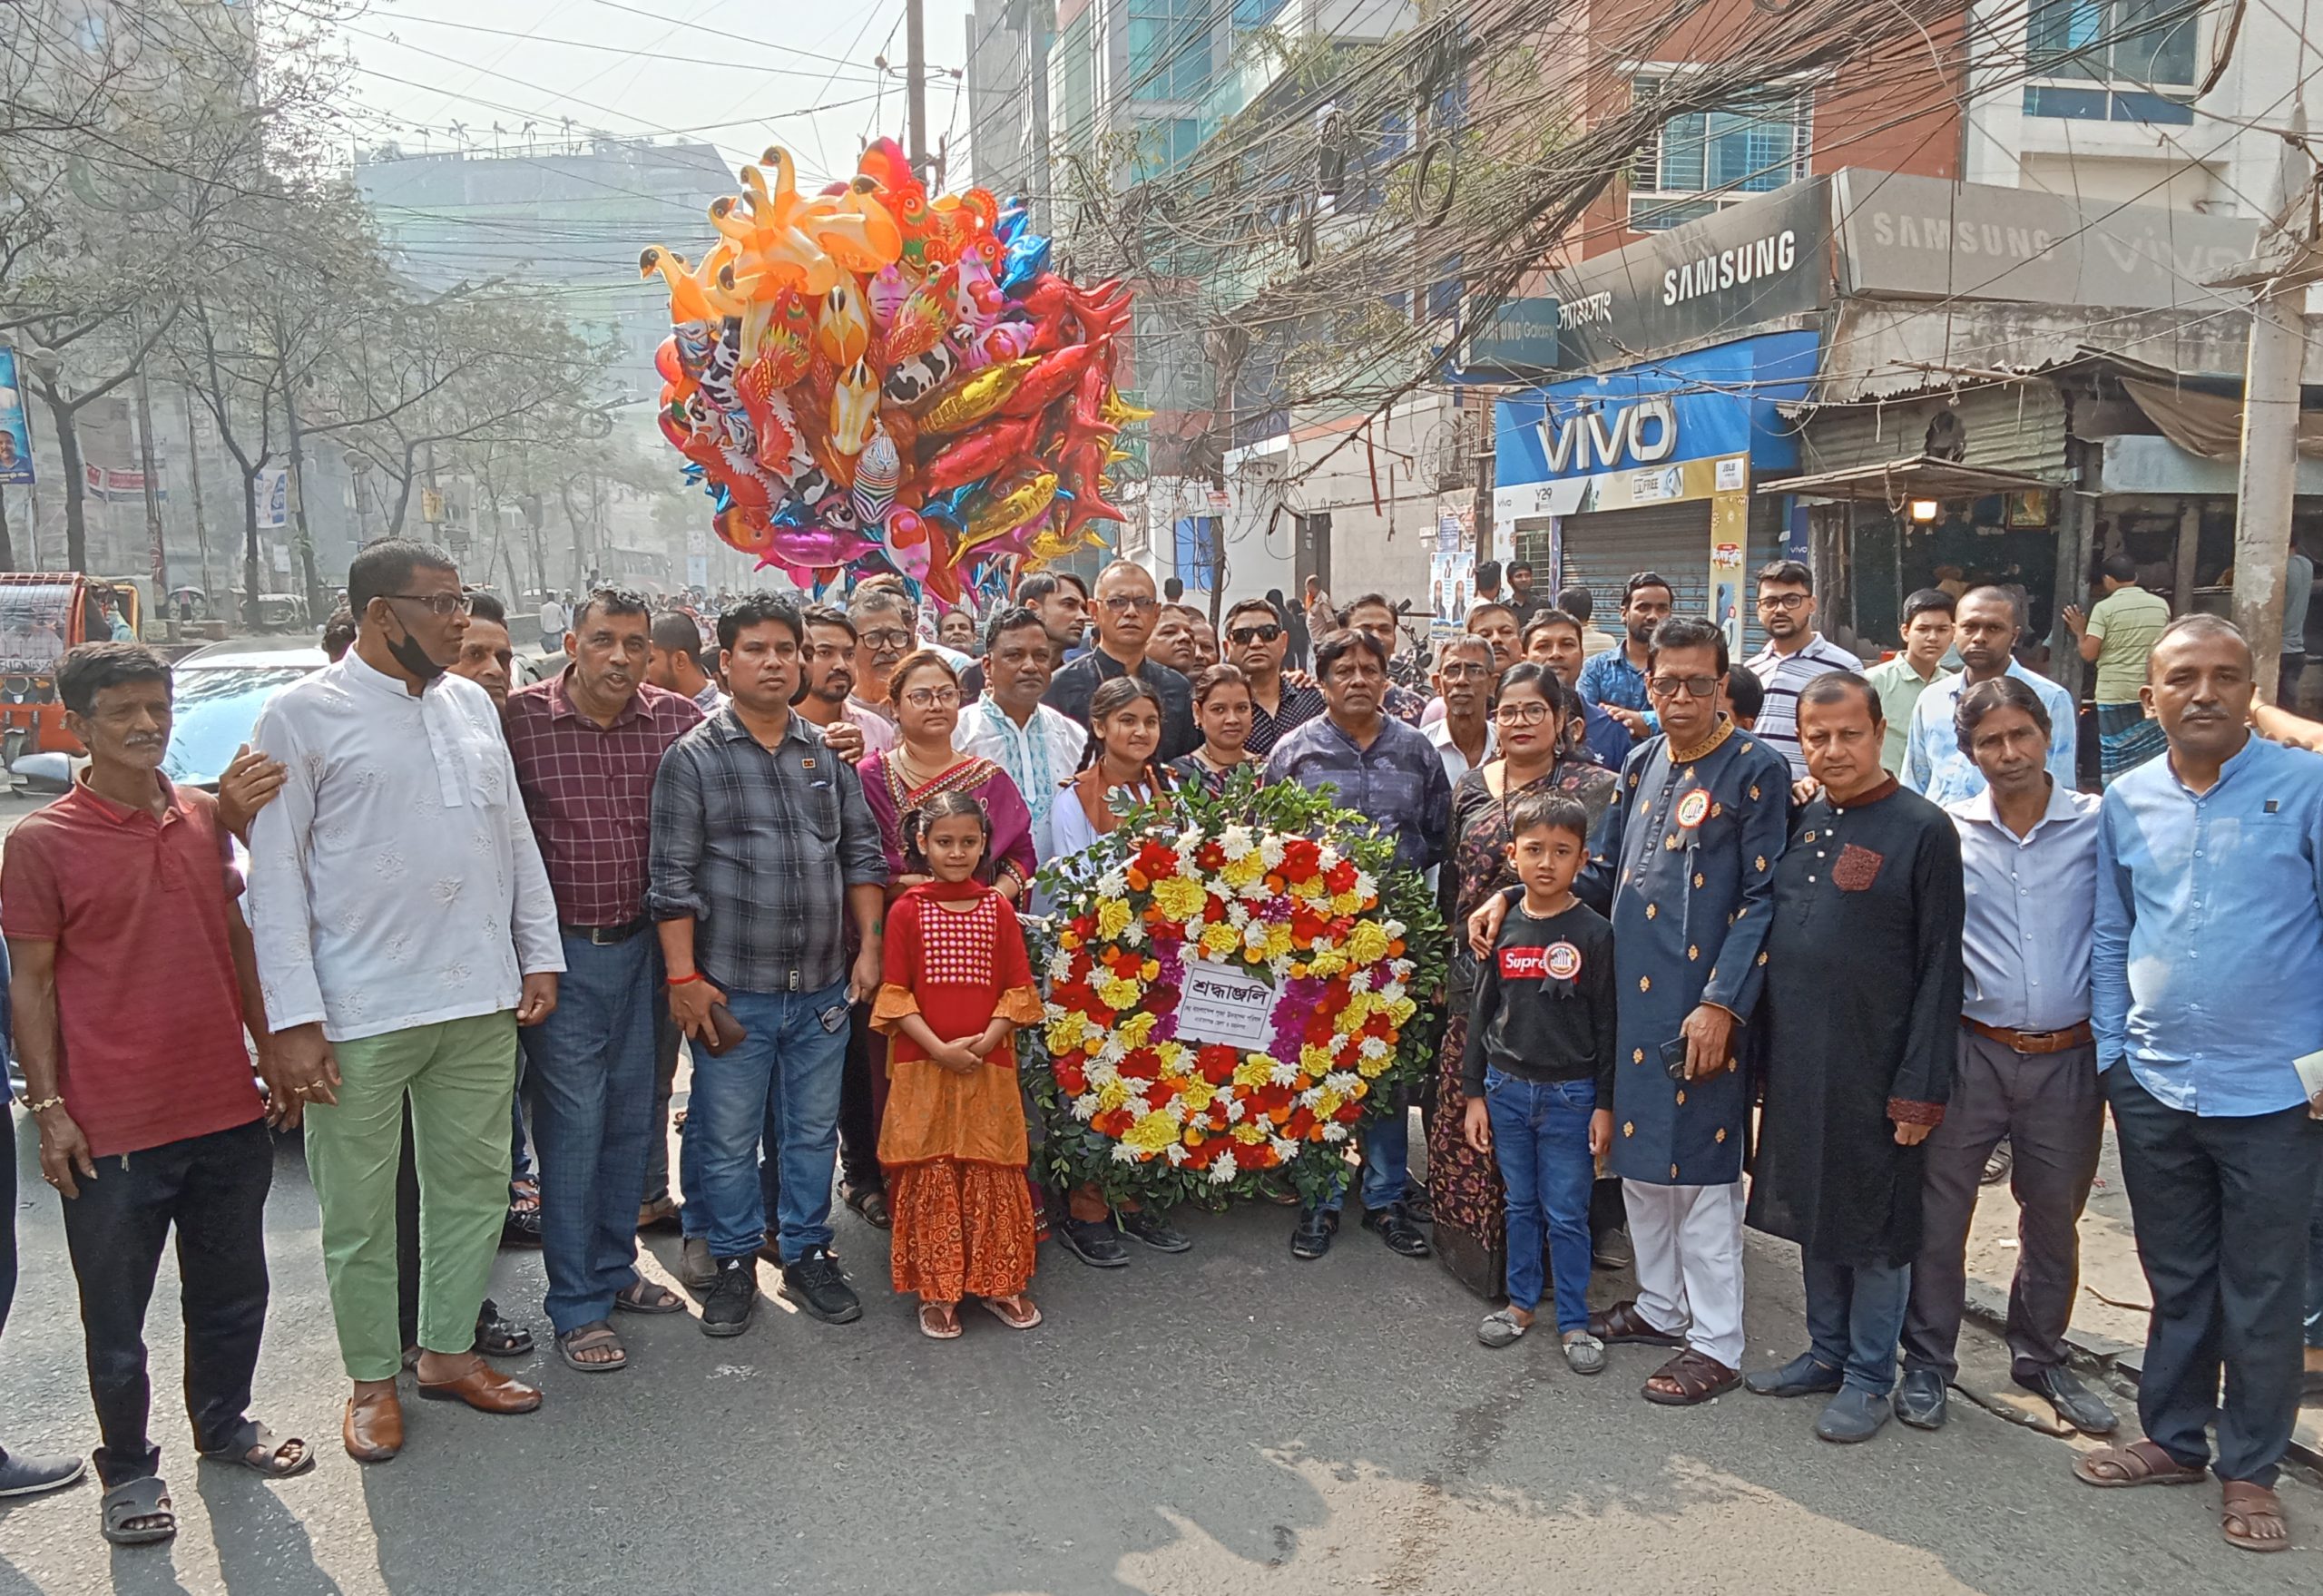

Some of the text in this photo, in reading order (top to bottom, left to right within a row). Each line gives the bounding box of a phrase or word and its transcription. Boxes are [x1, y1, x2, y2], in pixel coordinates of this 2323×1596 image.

[1873, 211, 2054, 260] SAMSUNG
[1663, 230, 1795, 306] SAMSUNG
[1524, 320, 1554, 343] Galaxy
[1536, 396, 1677, 473] vivo
[1497, 498, 1512, 508] vivo
[1789, 545, 1808, 553] vivo
[1505, 952, 1545, 974] Supre
[1192, 979, 1269, 1005] শ্রদ্ধাঞ্জলি
